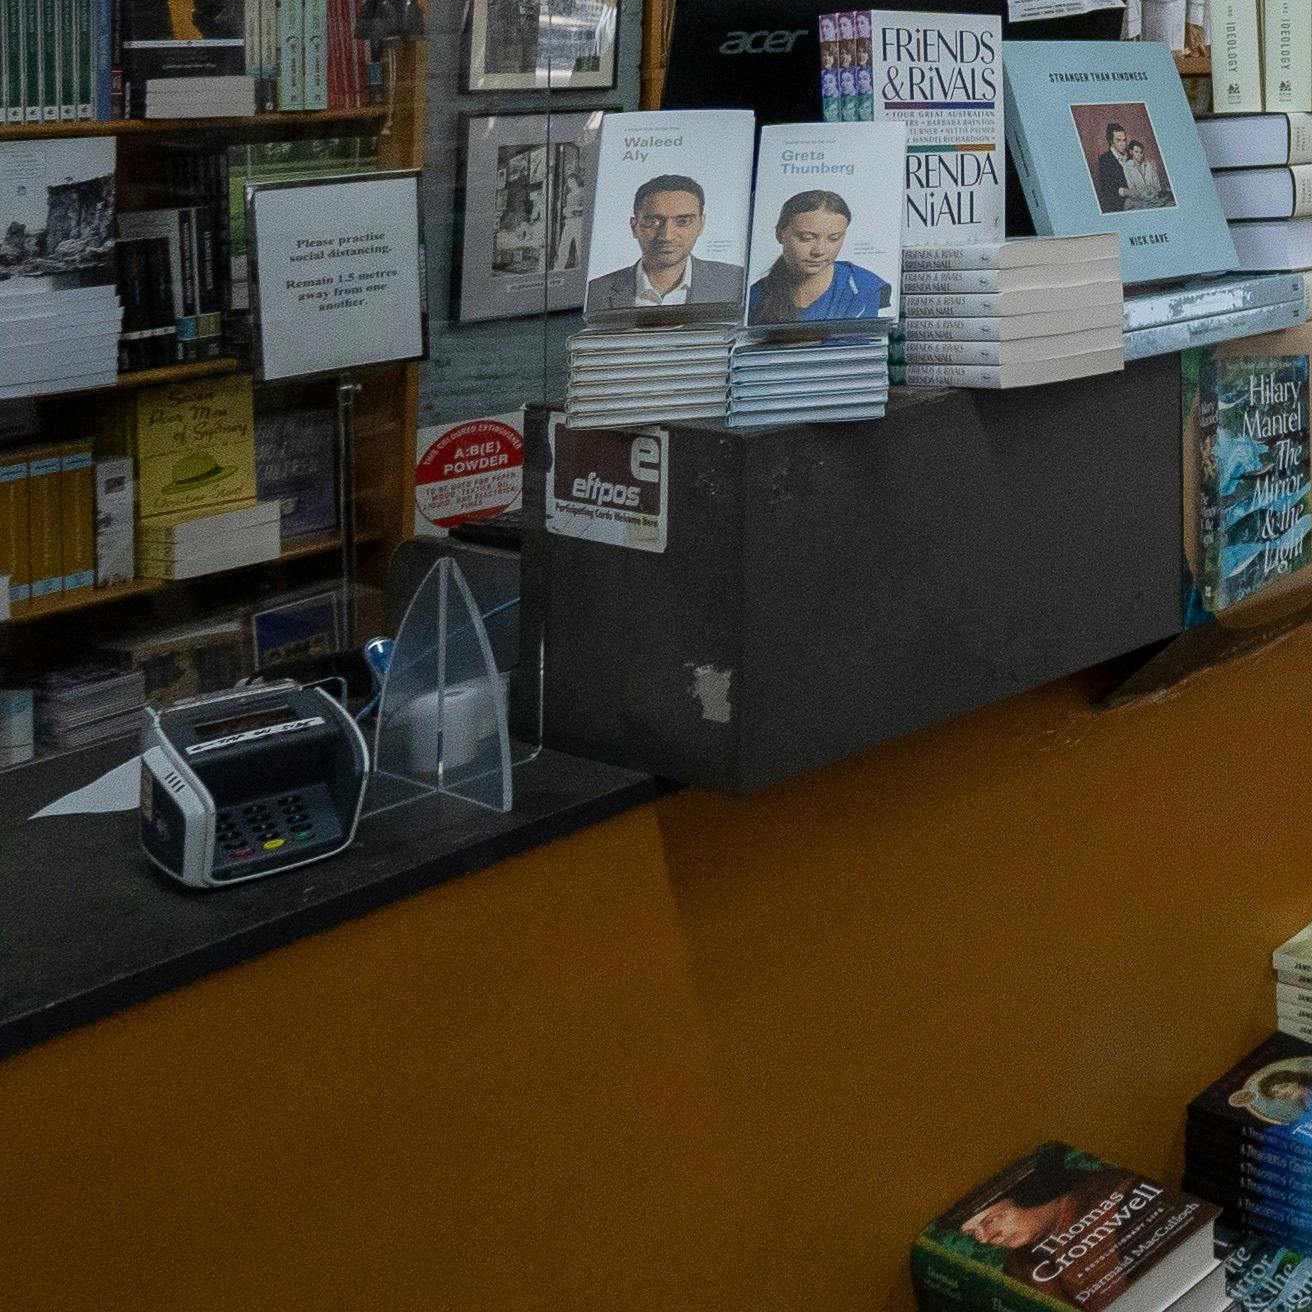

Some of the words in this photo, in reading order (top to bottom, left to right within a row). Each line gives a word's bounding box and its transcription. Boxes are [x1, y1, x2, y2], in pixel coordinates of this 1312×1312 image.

[718, 28, 809, 56] acer
[1049, 72, 1088, 84] STRANGER
[1089, 72, 1110, 83] THAN
[1111, 71, 1149, 82] KINDNESS
[622, 149, 649, 163] Aly
[624, 136, 683, 148] Waleed
[781, 149, 825, 162] Greta
[781, 162, 855, 176] Thunberg
[906, 153, 999, 190] RENDA
[289, 249, 329, 263] social
[329, 244, 393, 262] distancing.
[296, 236, 337, 250] Please
[338, 231, 386, 247] practise
[1129, 235, 1148, 248] NICK
[1149, 233, 1170, 246] CAVE
[286, 276, 335, 290] Remain
[336, 273, 355, 285] 1.5
[355, 269, 399, 283] metres
[297, 288, 331, 302] away
[331, 285, 364, 297] from
[365, 283, 388, 294] one
[318, 298, 368, 313] another.
[1248, 372, 1301, 410] Hilary
[1241, 403, 1302, 439] Mantel
[443, 453, 509, 475] POWDER
[1275, 439, 1302, 469] The
[571, 472, 642, 507] eftpos
[1252, 471, 1305, 508] Mirror
[1261, 512, 1279, 539] &
[1279, 503, 1305, 533] the
[1263, 534, 1305, 575] Light
[1031, 1189, 1125, 1258] Thomas
[1031, 1182, 1164, 1284] Cromwell
[1075, 1249, 1132, 1304] Diarmaid
[1132, 1201, 1200, 1255] MacCulloch
[1264, 1263, 1296, 1295] the
